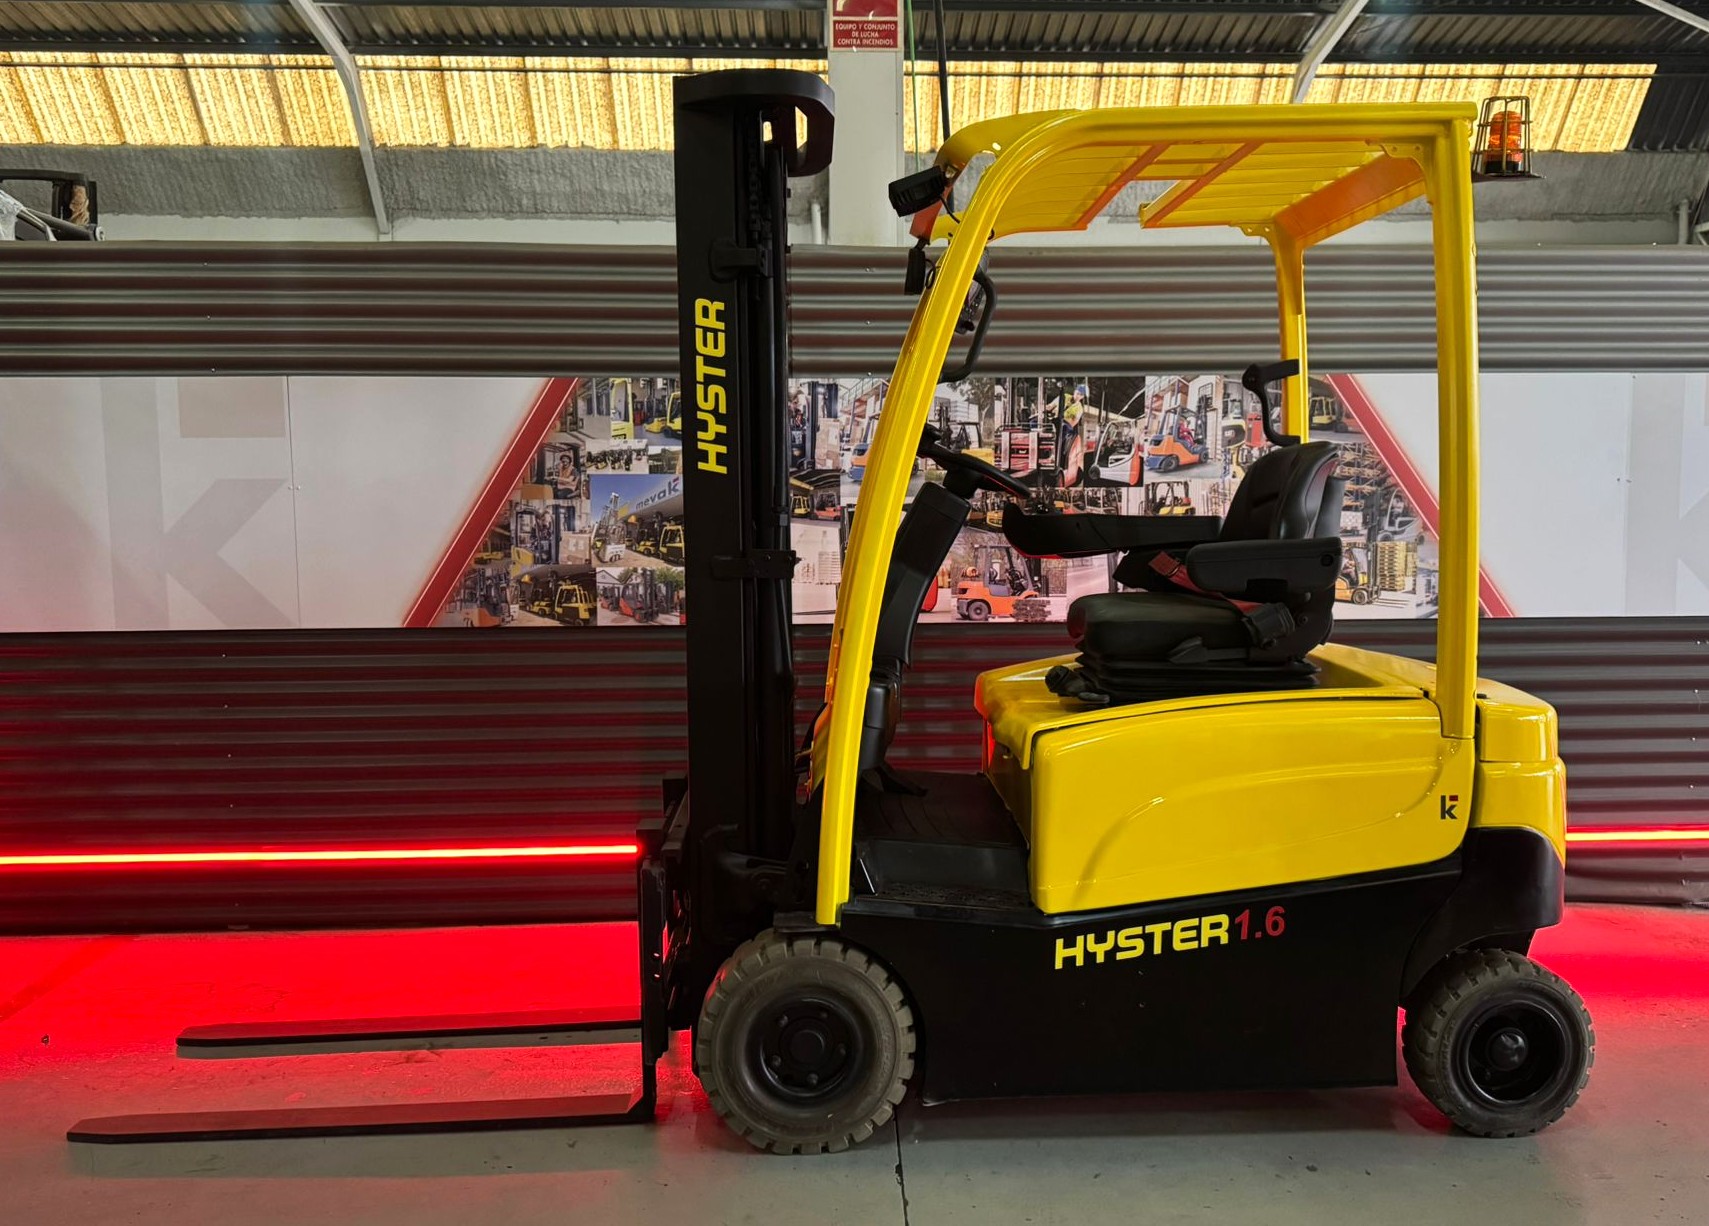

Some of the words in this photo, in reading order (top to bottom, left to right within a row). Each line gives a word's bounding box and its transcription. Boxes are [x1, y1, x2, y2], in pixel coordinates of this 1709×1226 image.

[835, 23, 857, 31] EQUIPO
[863, 23, 896, 31] CONJUNTO
[837, 38, 861, 46] CONTRA
[862, 38, 894, 46] INCENDIOS
[694, 297, 728, 475] HYSTER
[636, 476, 680, 510] mevak
[1054, 913, 1230, 970] HYSTER
[1234, 905, 1287, 940] 1.6
